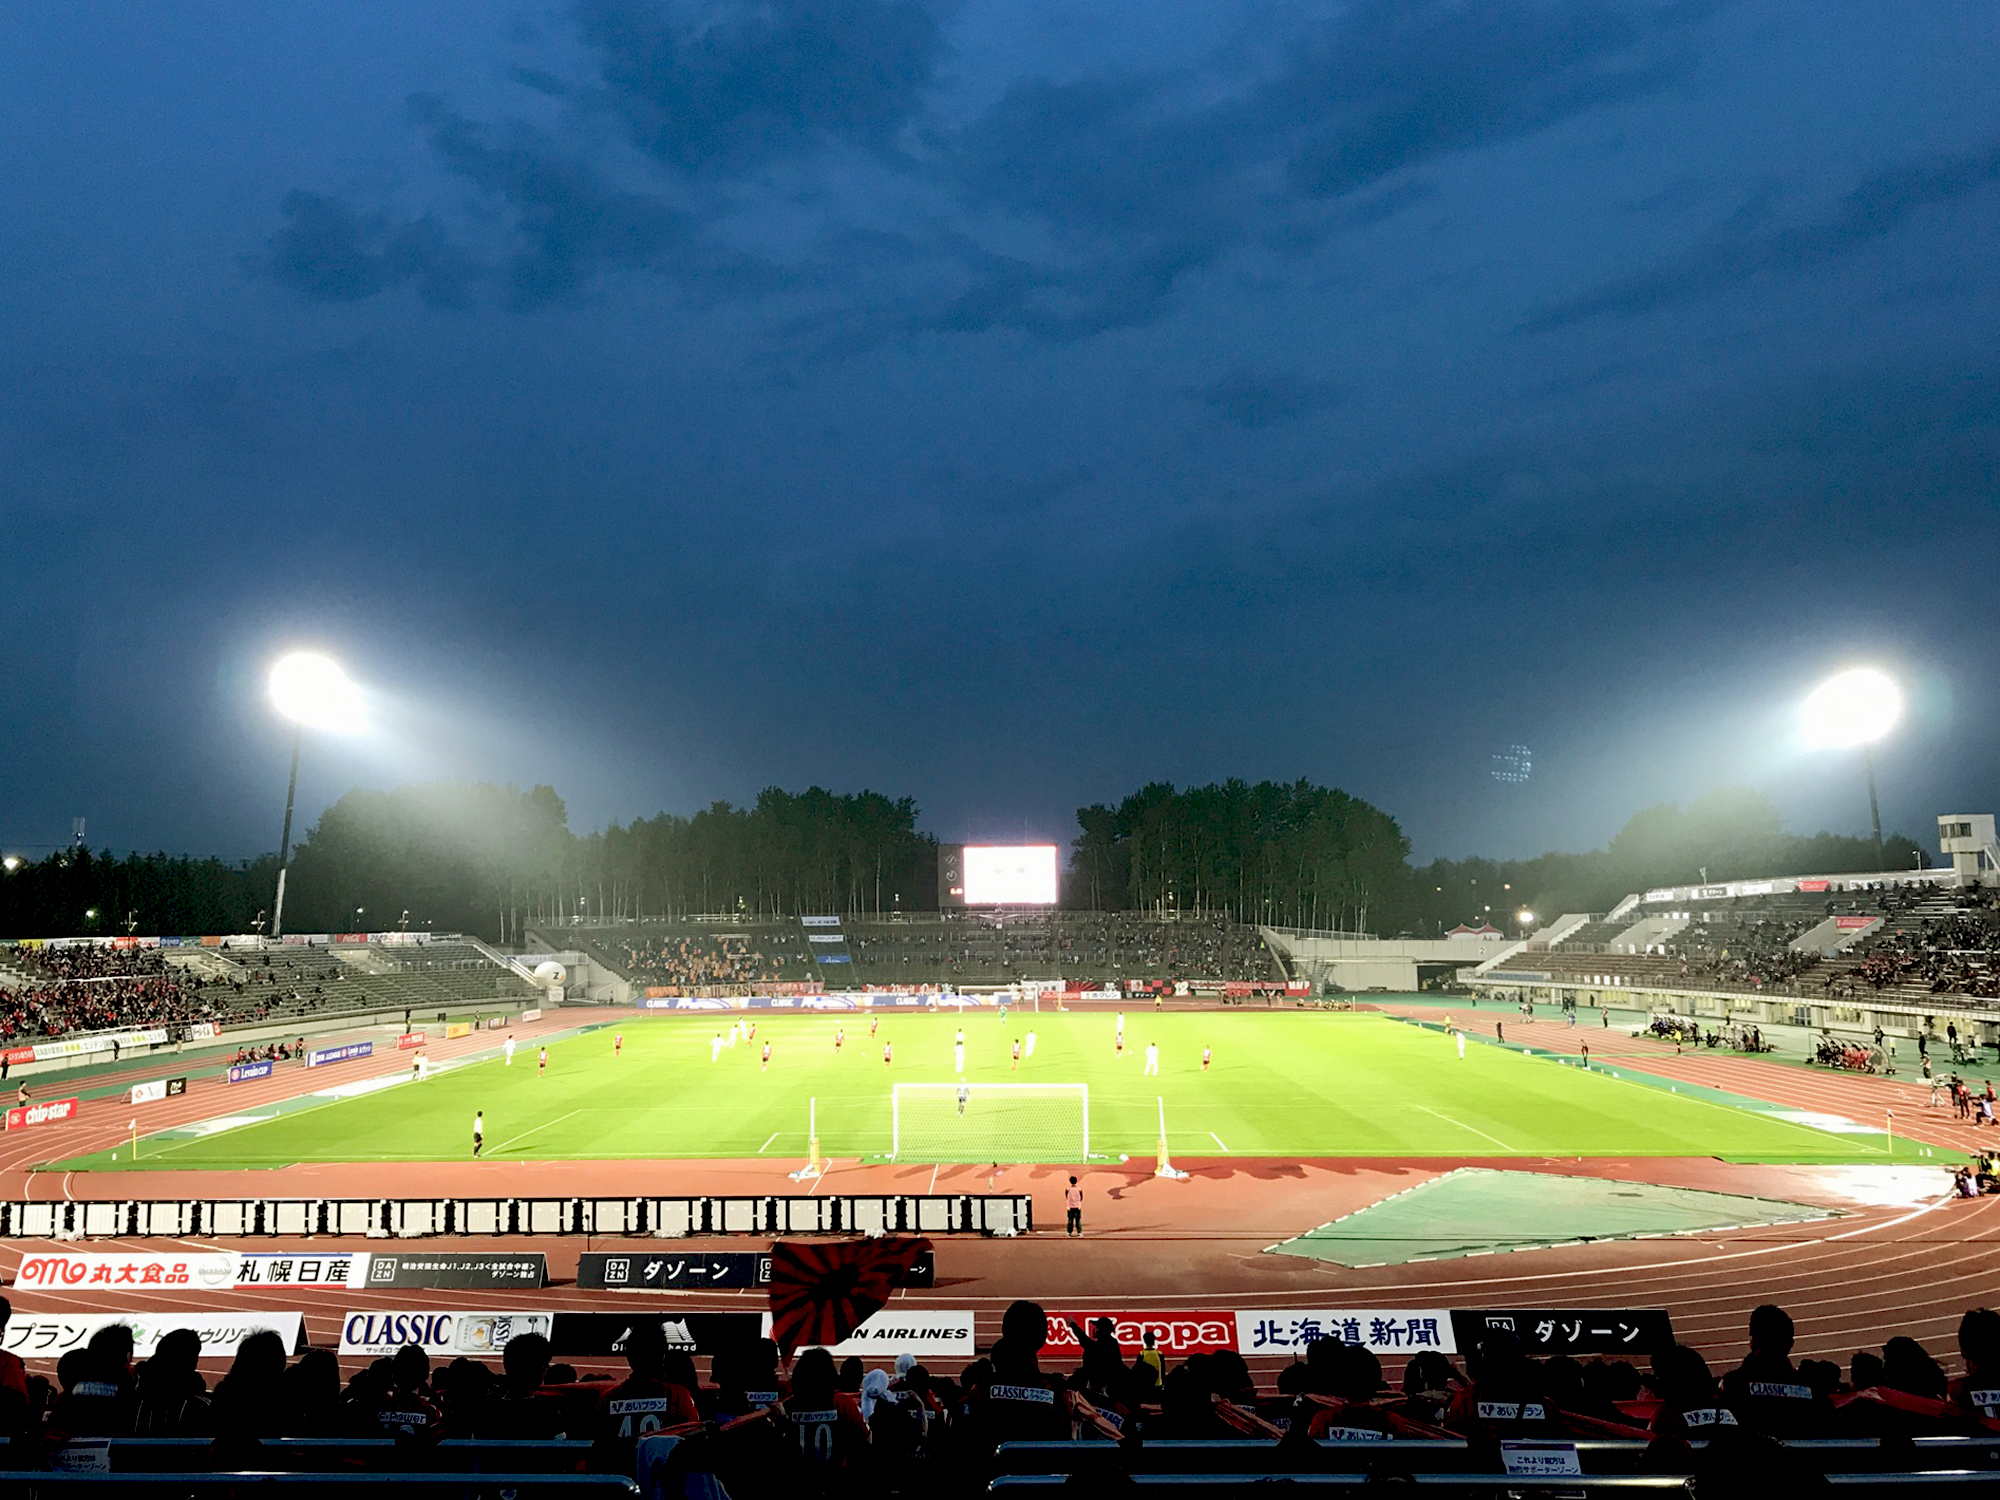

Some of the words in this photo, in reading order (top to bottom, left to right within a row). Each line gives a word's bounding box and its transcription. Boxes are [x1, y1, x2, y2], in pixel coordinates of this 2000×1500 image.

[1478, 946, 1486, 955] 2
[25, 1104, 48, 1125] chip
[48, 1103, 71, 1120] star
[89, 1263, 190, 1284] 丸大食品
[236, 1260, 351, 1283] 札幌日産
[643, 1260, 730, 1280] ダゾーン
[346, 1314, 452, 1345] CLASSIC
[872, 1329, 969, 1339] AIRLINES
[1253, 1317, 1442, 1348] 北海道新聞
[1534, 1319, 1640, 1343] ダゾーン
[991, 1386, 1028, 1400] CLASSIC
[625, 1400, 665, 1411] あいプラン
